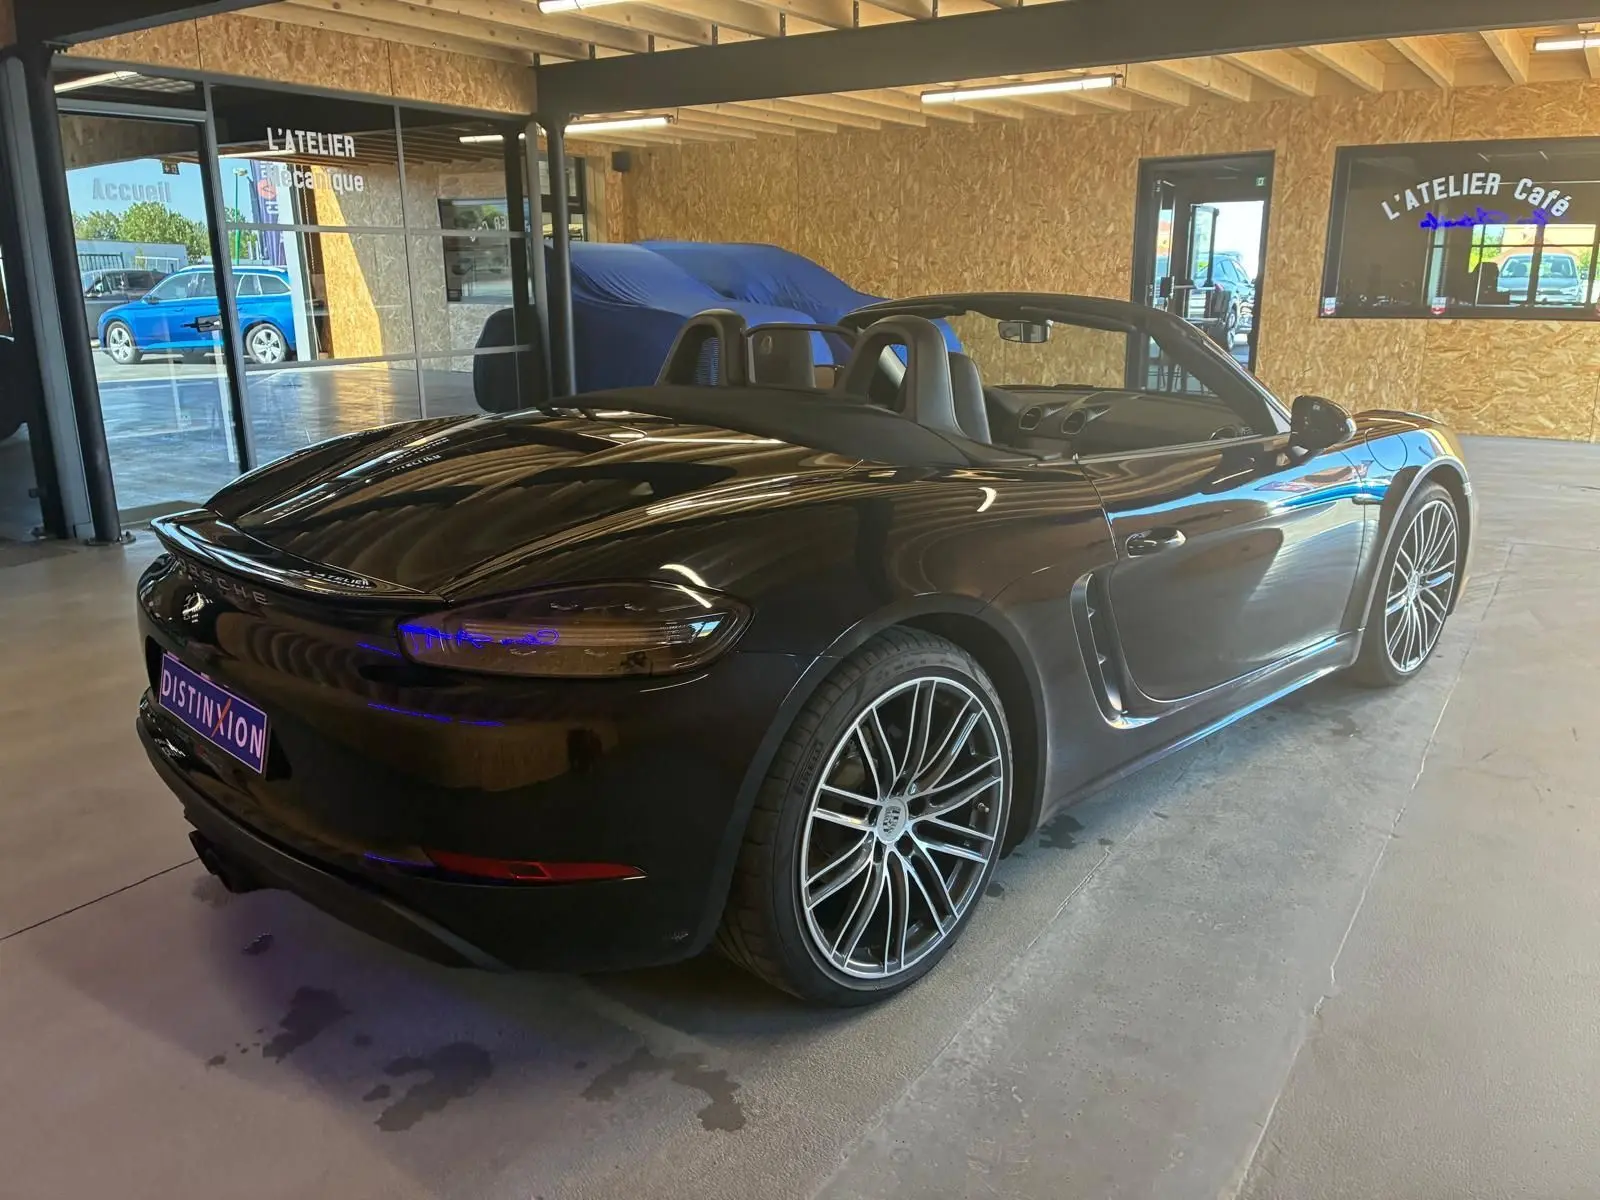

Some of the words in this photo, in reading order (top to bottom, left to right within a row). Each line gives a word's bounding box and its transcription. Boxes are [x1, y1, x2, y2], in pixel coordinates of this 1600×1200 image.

[266, 126, 356, 158] L'ATELIER
[92, 177, 172, 203] Accueil
[1382, 173, 1501, 220] L'ATELIER
[1514, 178, 1571, 217] Café
[161, 670, 263, 759] DISTINXION
